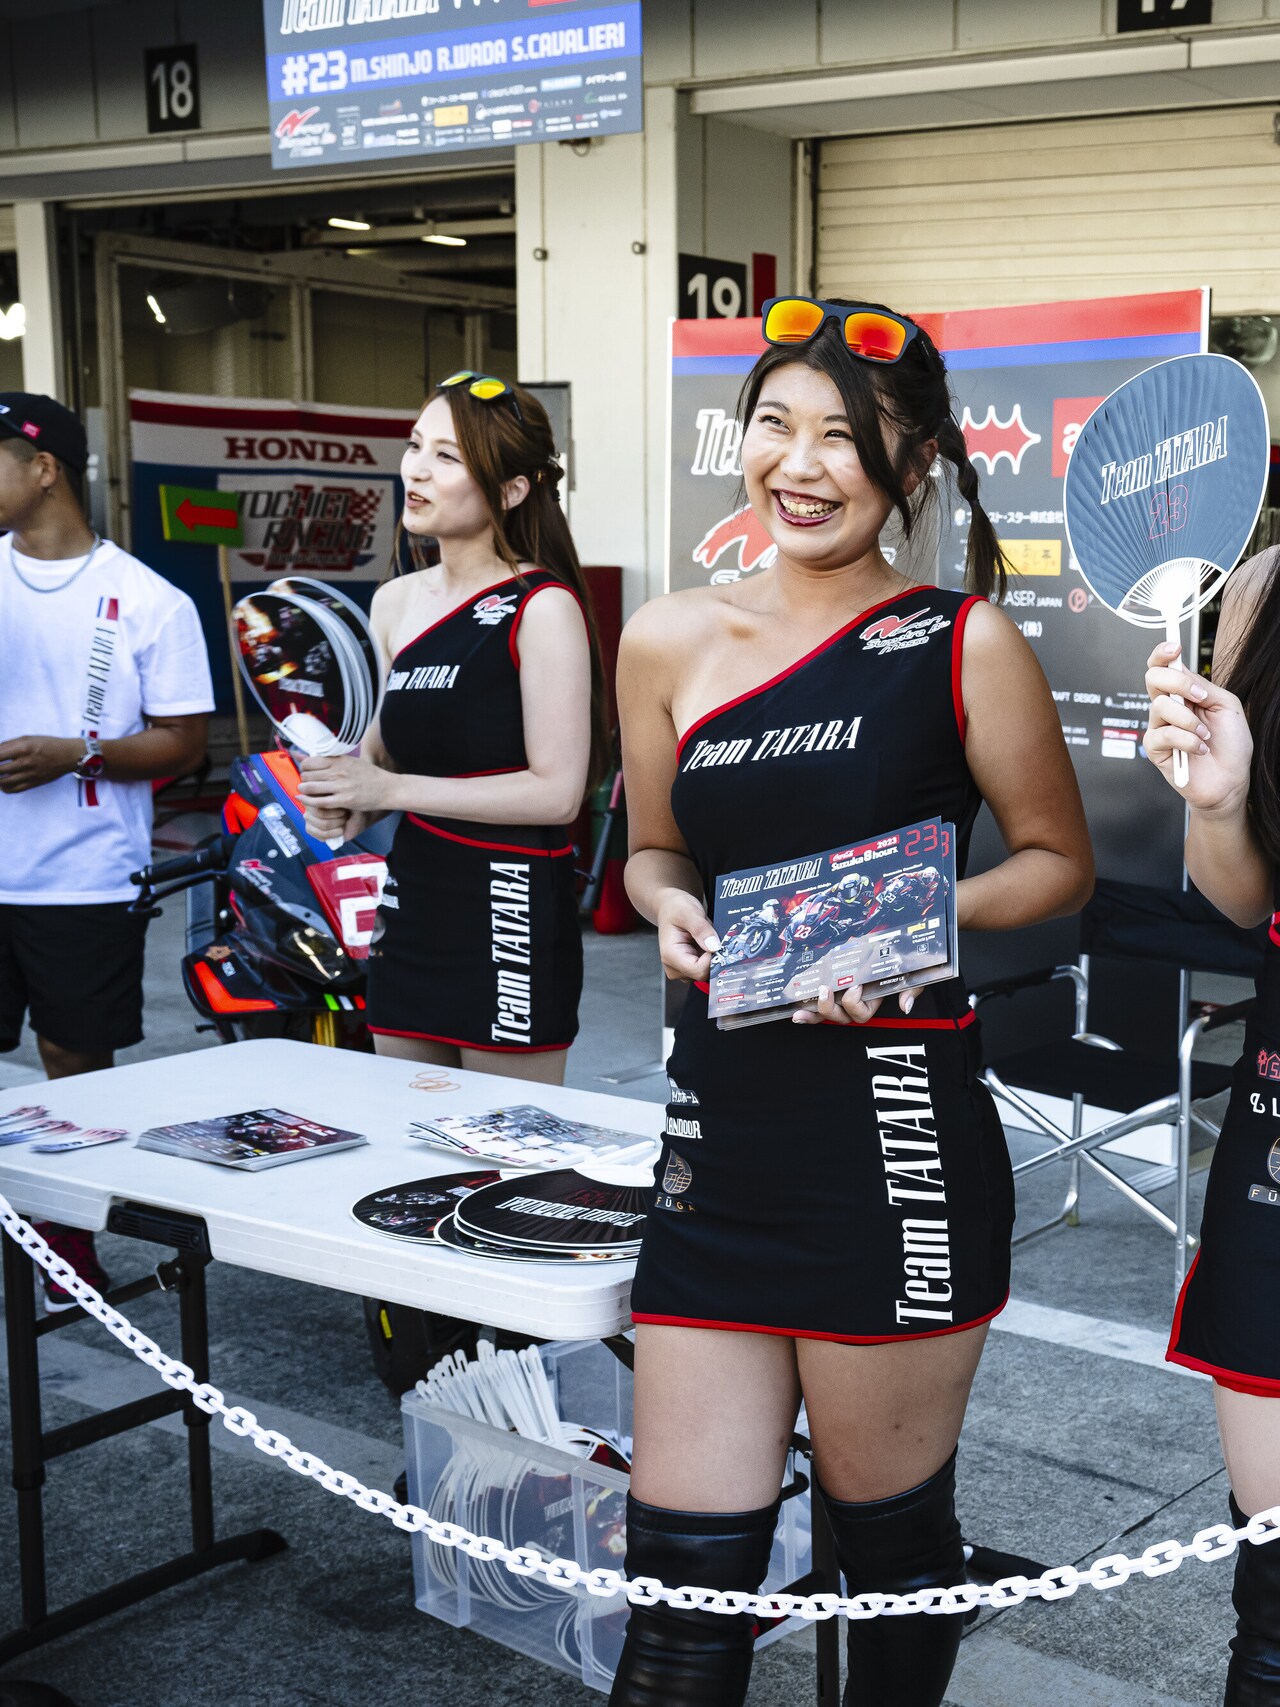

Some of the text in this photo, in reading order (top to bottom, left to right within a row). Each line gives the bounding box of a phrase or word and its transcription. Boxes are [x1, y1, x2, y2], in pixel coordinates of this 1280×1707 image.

[281, 21, 626, 96] #23 M.SHINJO R.WADA S.CAVALIERI
[152, 61, 193, 119] 18
[687, 273, 741, 319] 19
[225, 436, 378, 465] HONDA
[1101, 453, 1153, 505] Team
[1154, 414, 1229, 484] TATARA
[262, 519, 377, 550] RACING
[1149, 484, 1189, 540] 23
[82, 627, 116, 725] Team TATARA
[405, 665, 461, 690] TATARA
[682, 716, 863, 773] Team TATARA
[831, 846, 899, 872] Suzuka 8 hours
[876, 836, 898, 849] 2023
[904, 824, 939, 857] 23
[720, 858, 823, 899] Team TATARA
[489, 861, 532, 1044] Team TATARA
[794, 924, 812, 939] 23
[866, 1044, 947, 1206] TATARA
[896, 1218, 953, 1325] Team
